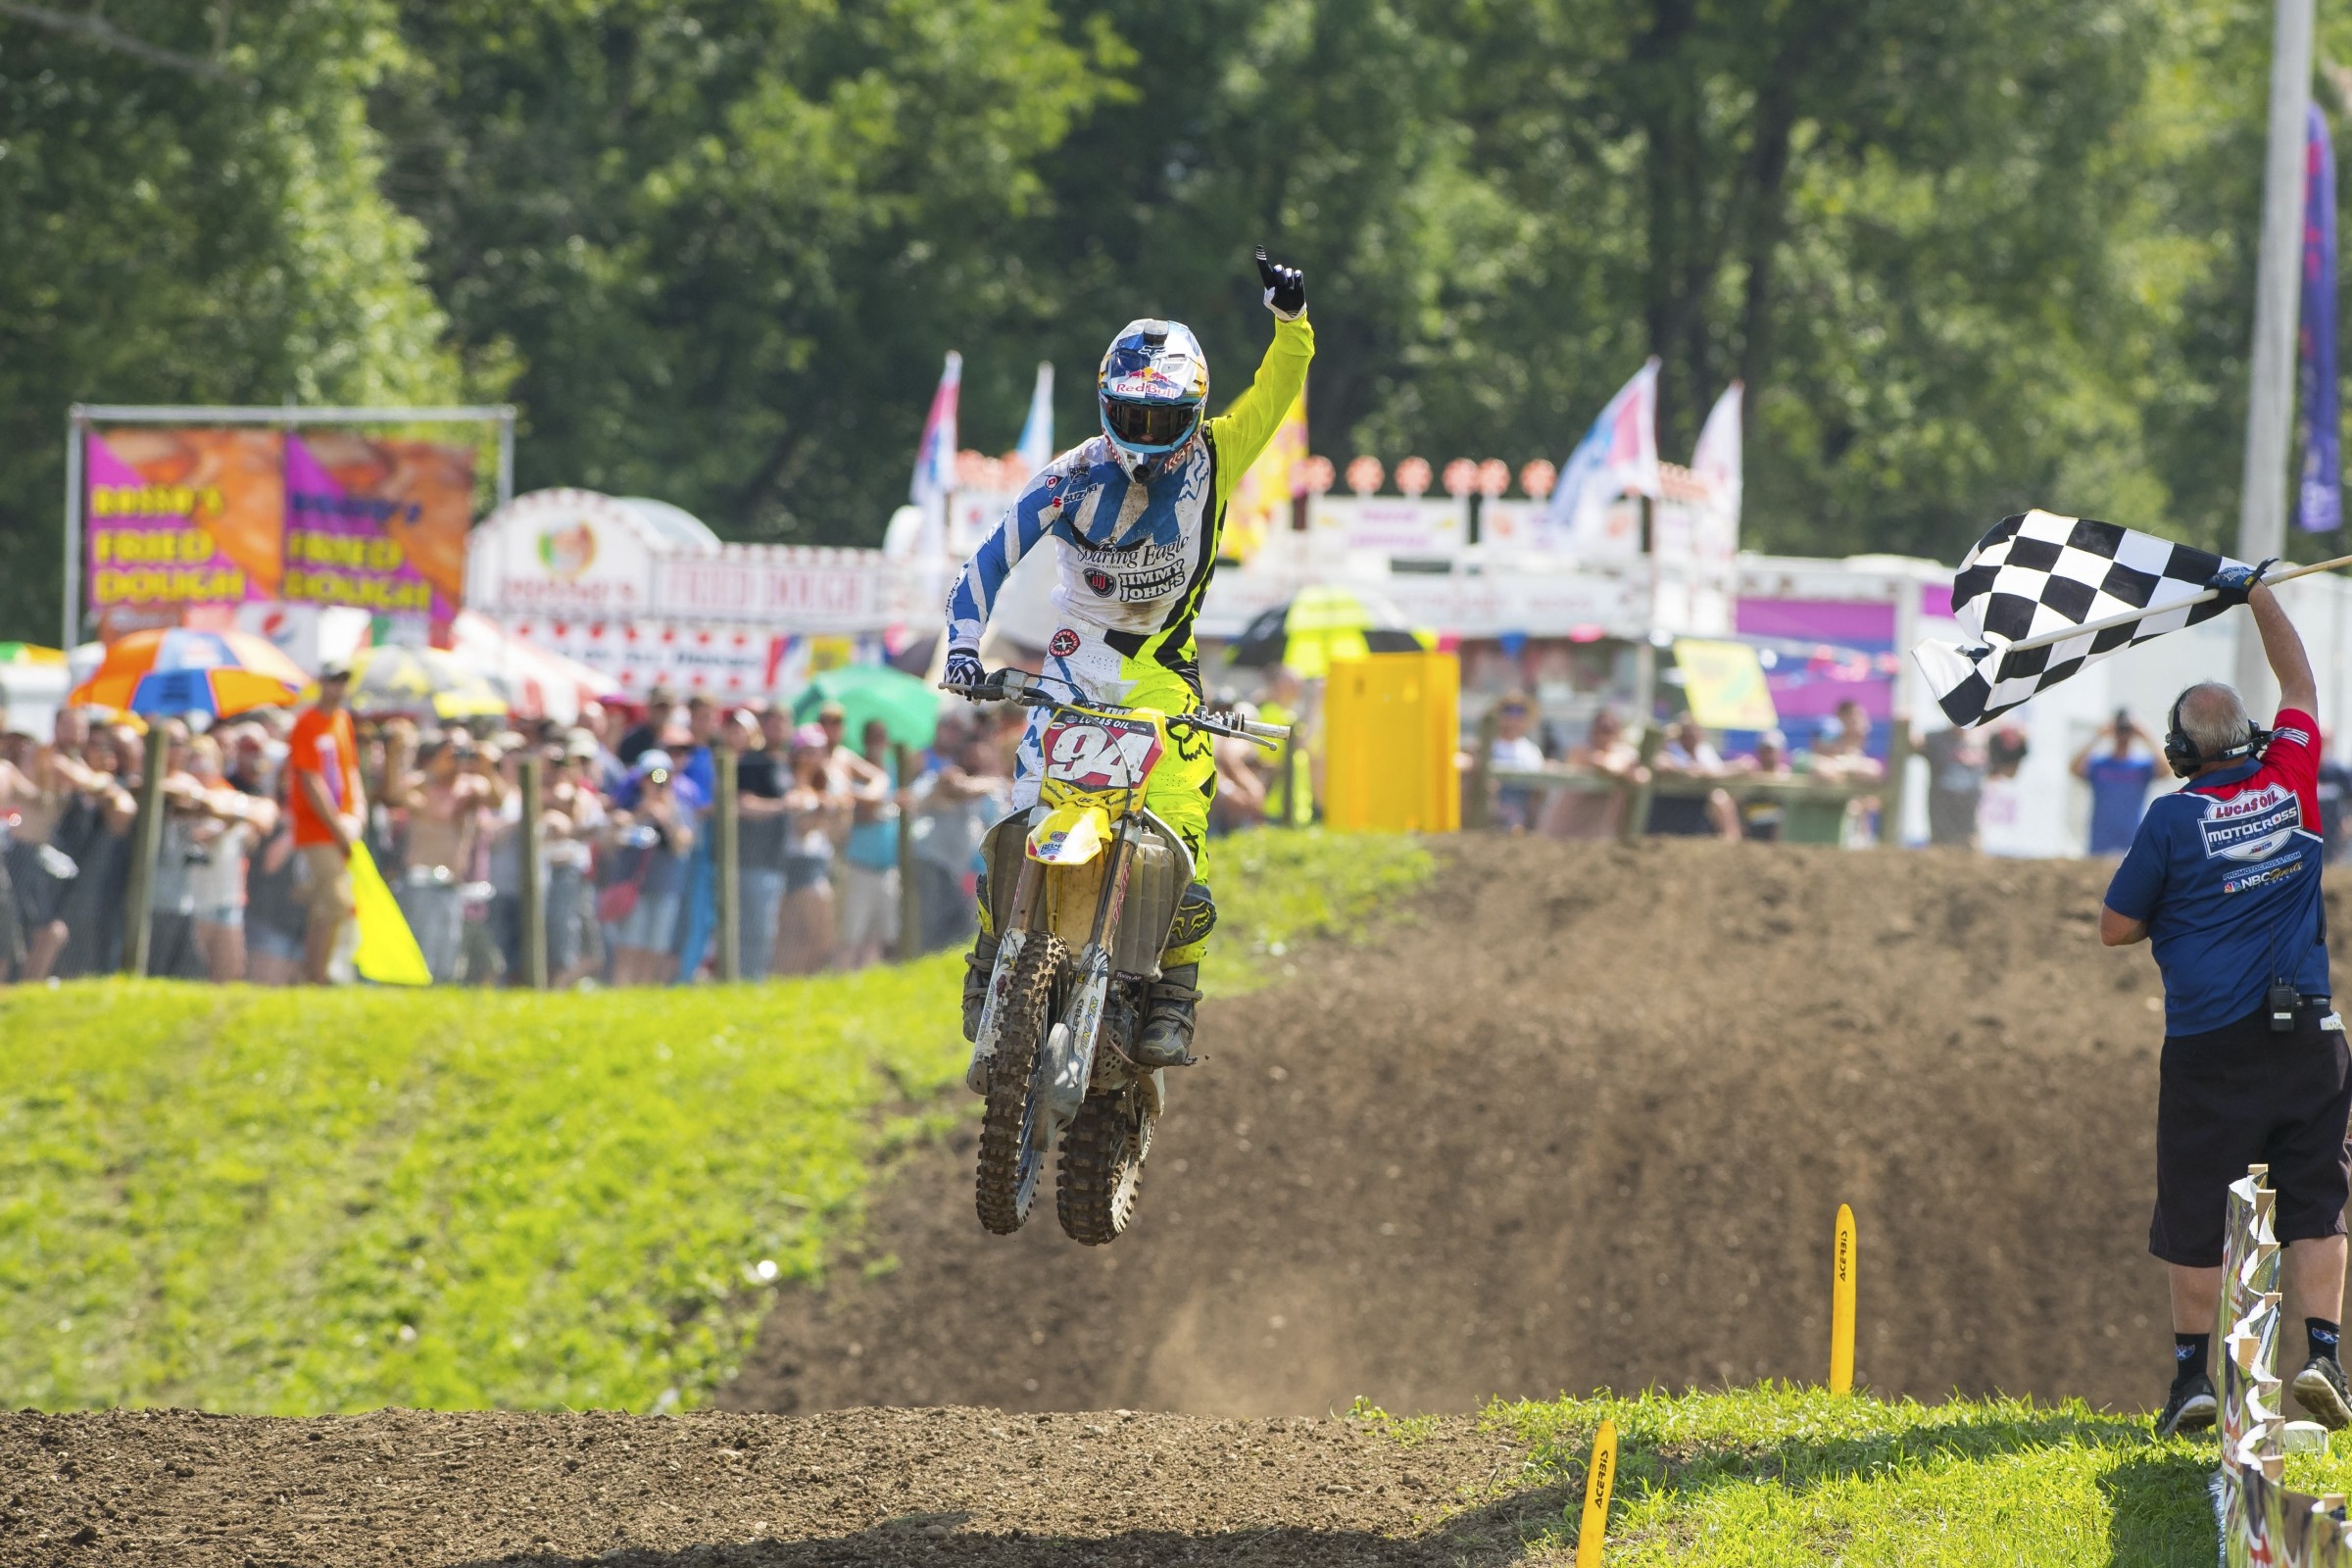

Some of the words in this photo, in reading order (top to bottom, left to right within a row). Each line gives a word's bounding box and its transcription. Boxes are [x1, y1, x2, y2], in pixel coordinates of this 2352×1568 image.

[1116, 382, 1146, 394] Red
[1147, 383, 1176, 400] Bull
[1077, 544, 1139, 569] Soaring
[1142, 534, 1189, 567] Eagle
[1118, 559, 1184, 585] JIMMY
[1119, 572, 1185, 602] JOHN'S
[1079, 715, 1113, 726] LUCAS
[1112, 718, 1130, 730] OIL
[1047, 725, 1154, 788] 94
[2216, 797, 2259, 819] LUCAS
[2259, 790, 2278, 808] OIL
[2208, 807, 2298, 843] MOTOCROSS
[2223, 851, 2302, 881] PROMOTOCROSS.COM
[2240, 871, 2271, 890] NBC
[2269, 861, 2303, 882] Sports
[1839, 1230, 1848, 1282] ACERBIS
[1594, 1449, 1609, 1509] ACERBIS
